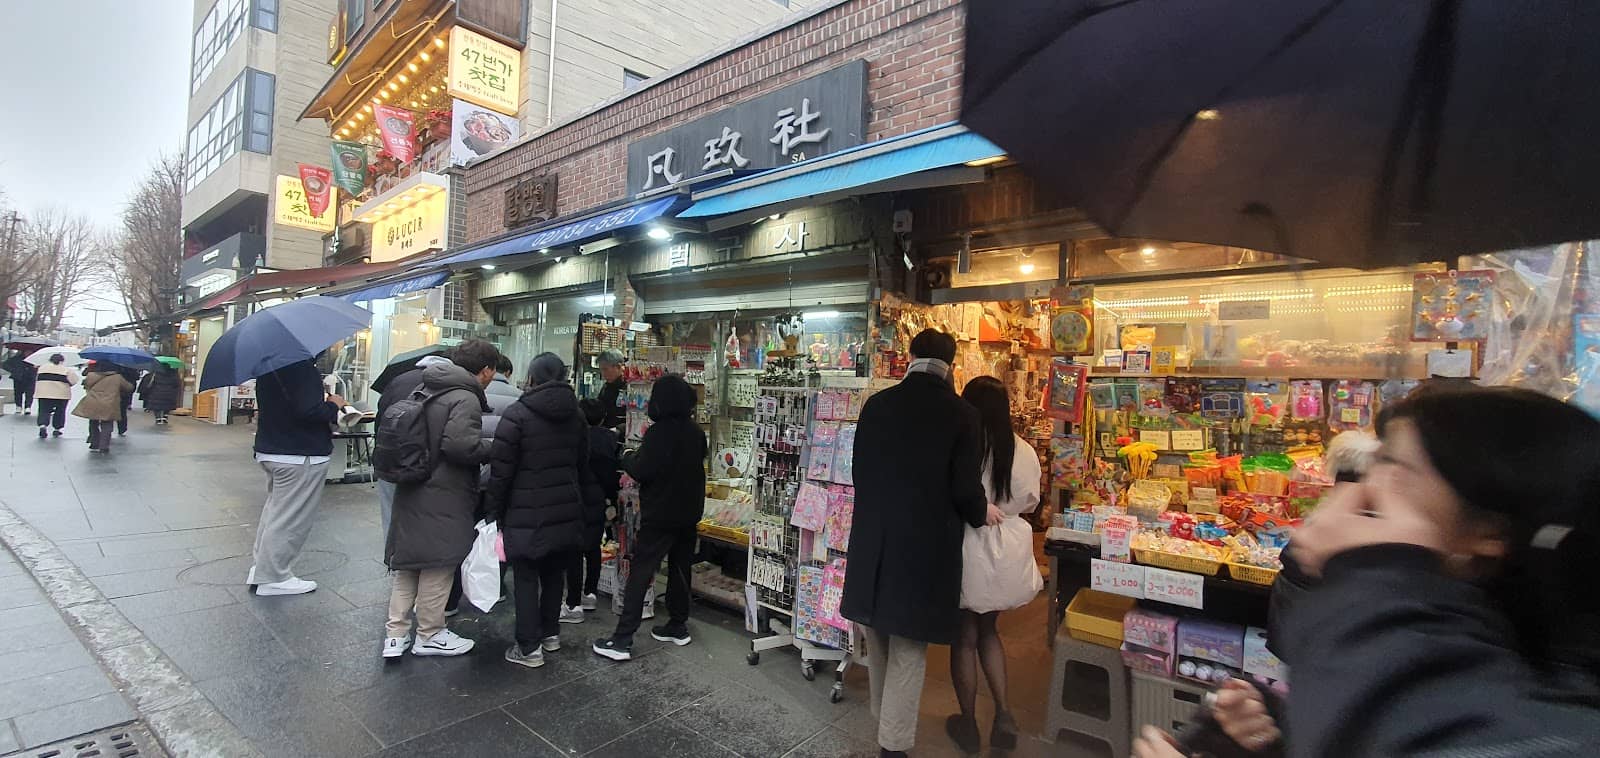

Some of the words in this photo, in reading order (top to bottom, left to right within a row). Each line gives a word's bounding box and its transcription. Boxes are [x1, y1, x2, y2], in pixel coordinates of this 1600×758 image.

[461, 48, 513, 77] 47번가
[468, 66, 505, 92] 찻집
[791, 152, 806, 163] SA
[396, 216, 424, 240] LUCIR
